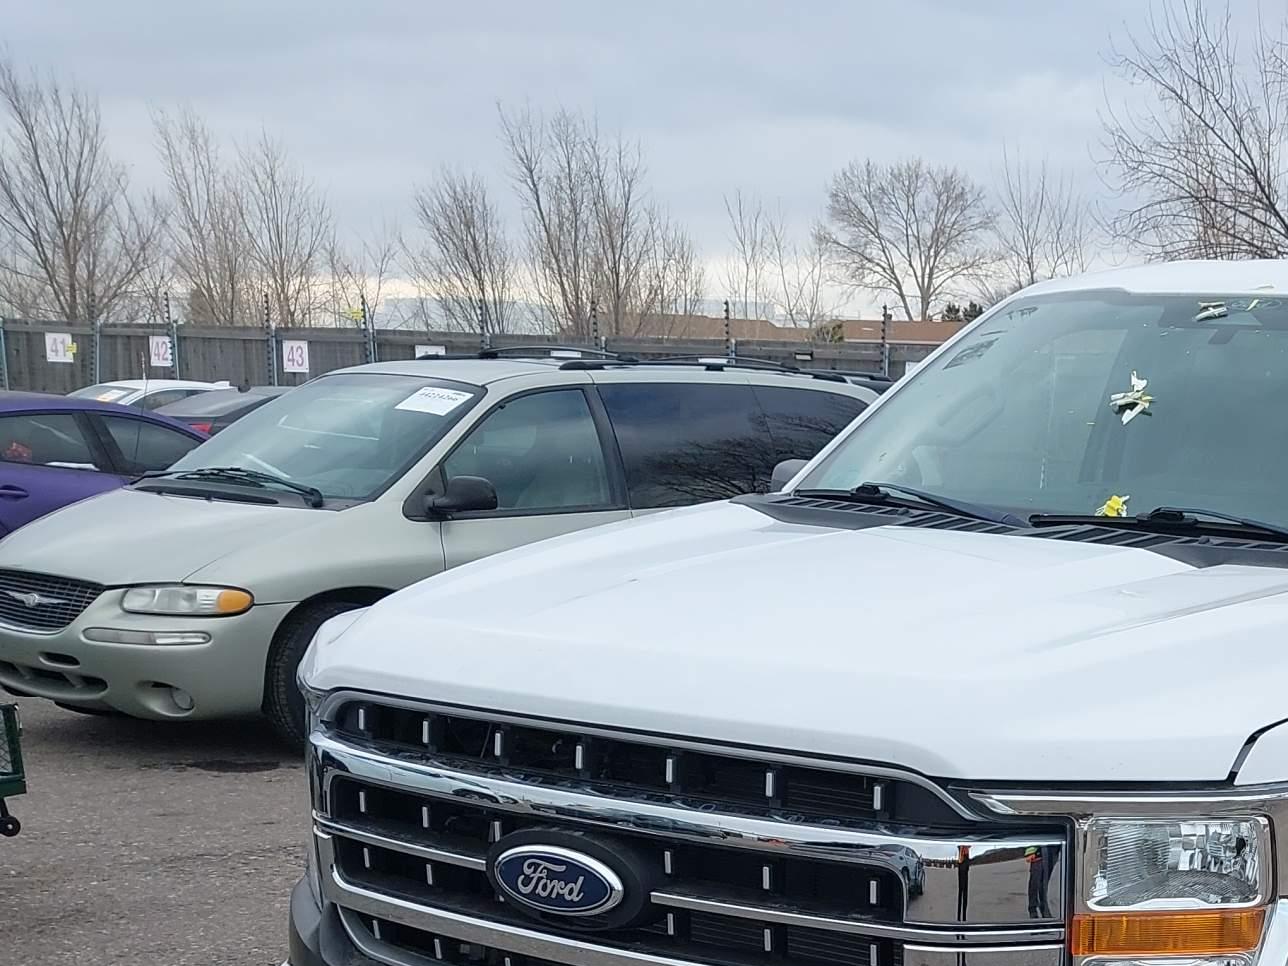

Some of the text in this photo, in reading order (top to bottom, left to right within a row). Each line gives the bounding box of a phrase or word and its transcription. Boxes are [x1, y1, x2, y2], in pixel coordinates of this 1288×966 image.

[50, 337, 67, 358] 41
[153, 340, 169, 361] 42
[286, 344, 305, 367] 43
[517, 858, 585, 902] Ford
